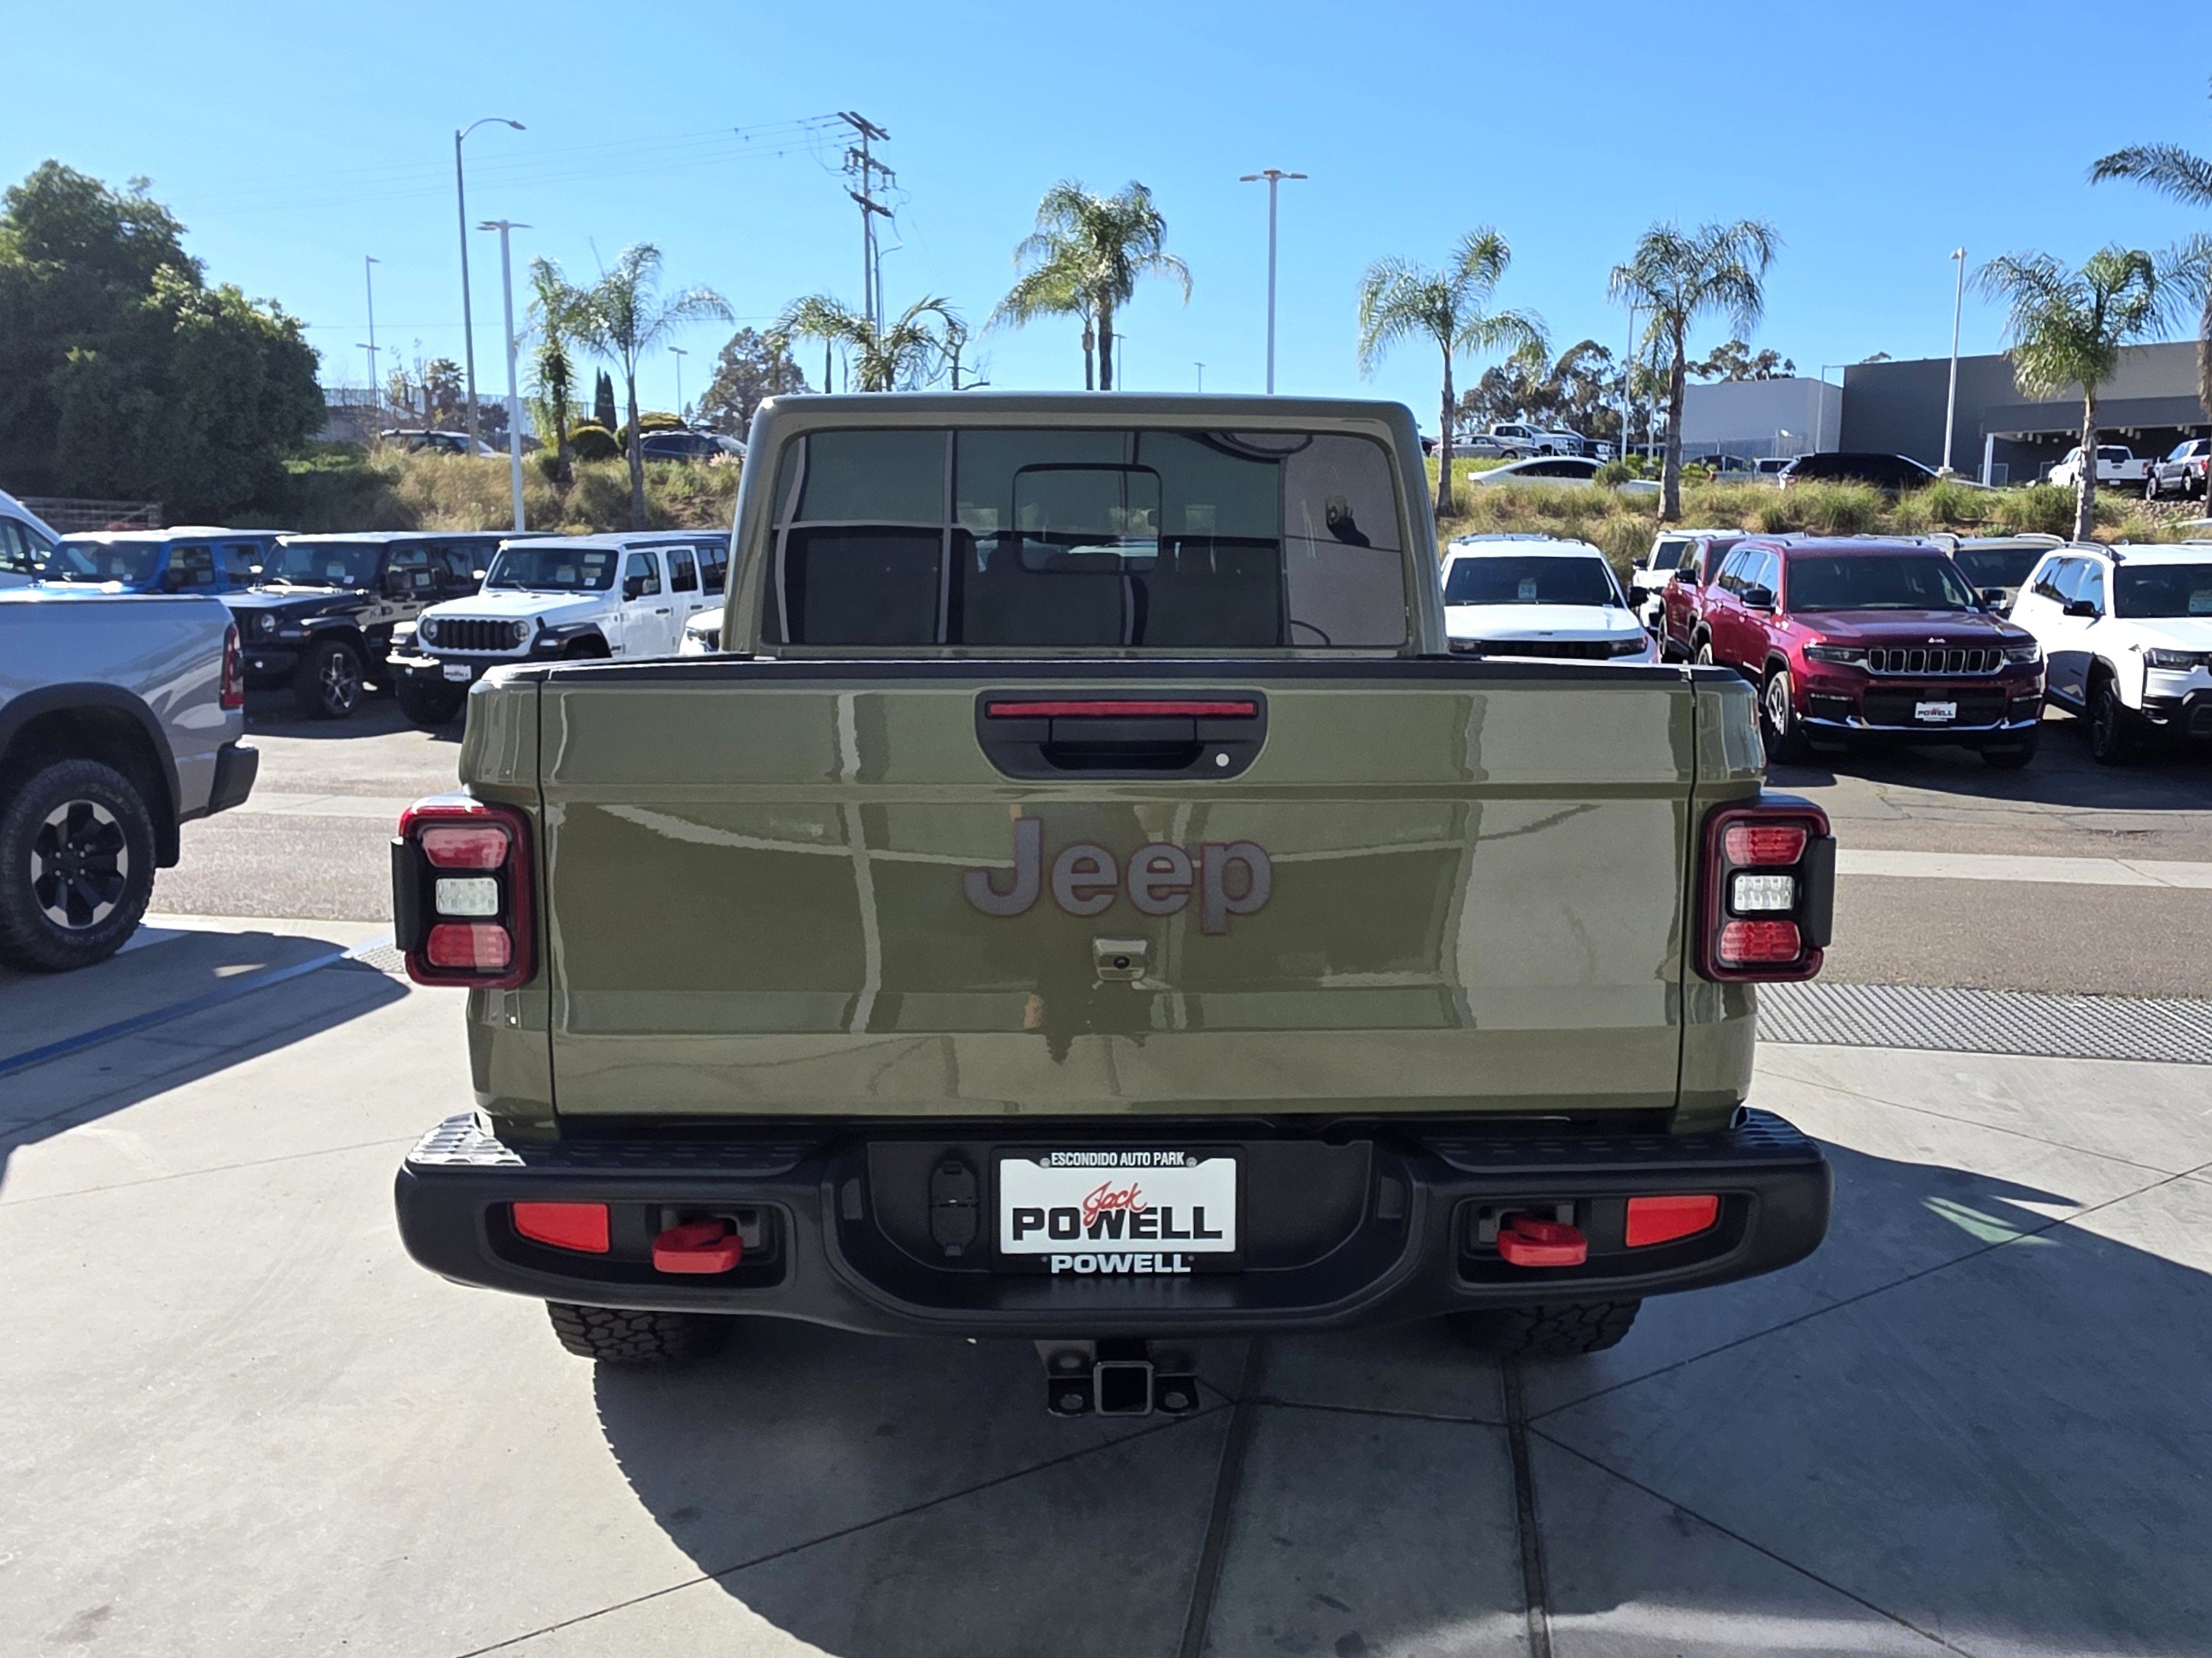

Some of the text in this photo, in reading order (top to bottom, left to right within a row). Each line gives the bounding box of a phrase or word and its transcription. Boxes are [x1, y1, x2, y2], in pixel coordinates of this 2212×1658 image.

[963, 816, 1273, 935] Jeep
[1051, 1152, 1185, 1166] ESCONDIDO AUTO PARK
[1083, 1181, 1147, 1227] Jack
[1012, 1206, 1223, 1240] POWELL
[1051, 1254, 1192, 1274] POWELL
